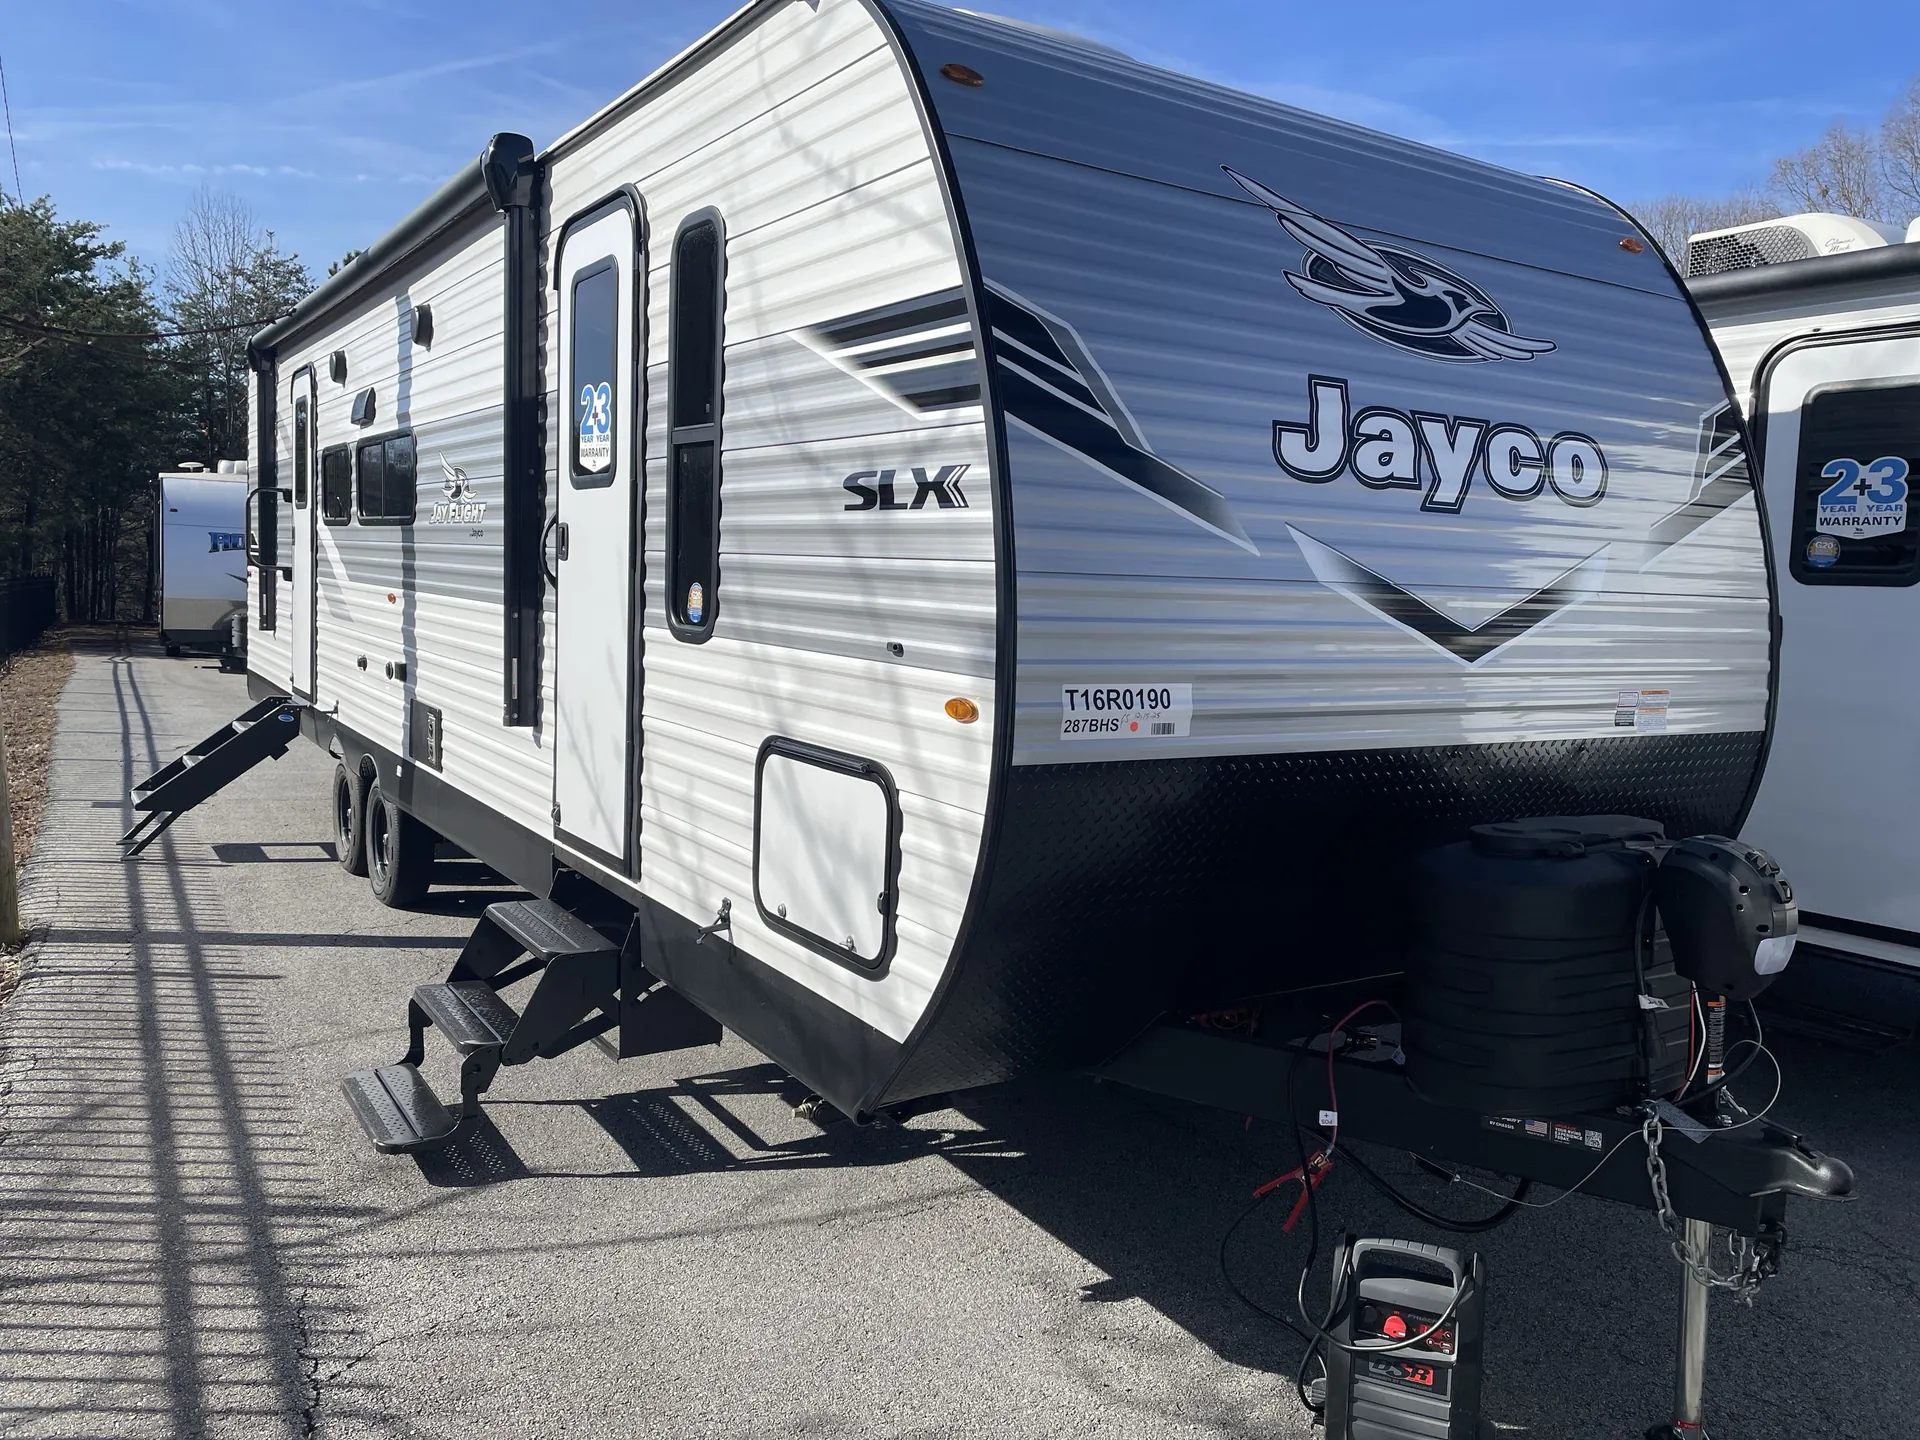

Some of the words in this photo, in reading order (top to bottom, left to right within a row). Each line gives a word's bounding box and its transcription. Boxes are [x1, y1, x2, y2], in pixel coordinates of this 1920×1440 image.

[1273, 374, 1608, 514] Jayco
[581, 447, 609, 457] WARRANTY
[843, 464, 971, 511] SLX
[1865, 504, 1903, 512] YEAR
[1819, 516, 1902, 526] WARRANTY
[1065, 688, 1171, 711] T16R0190
[1063, 718, 1119, 733] 287BHS
[1496, 1121, 1515, 1130] CHASSIS
